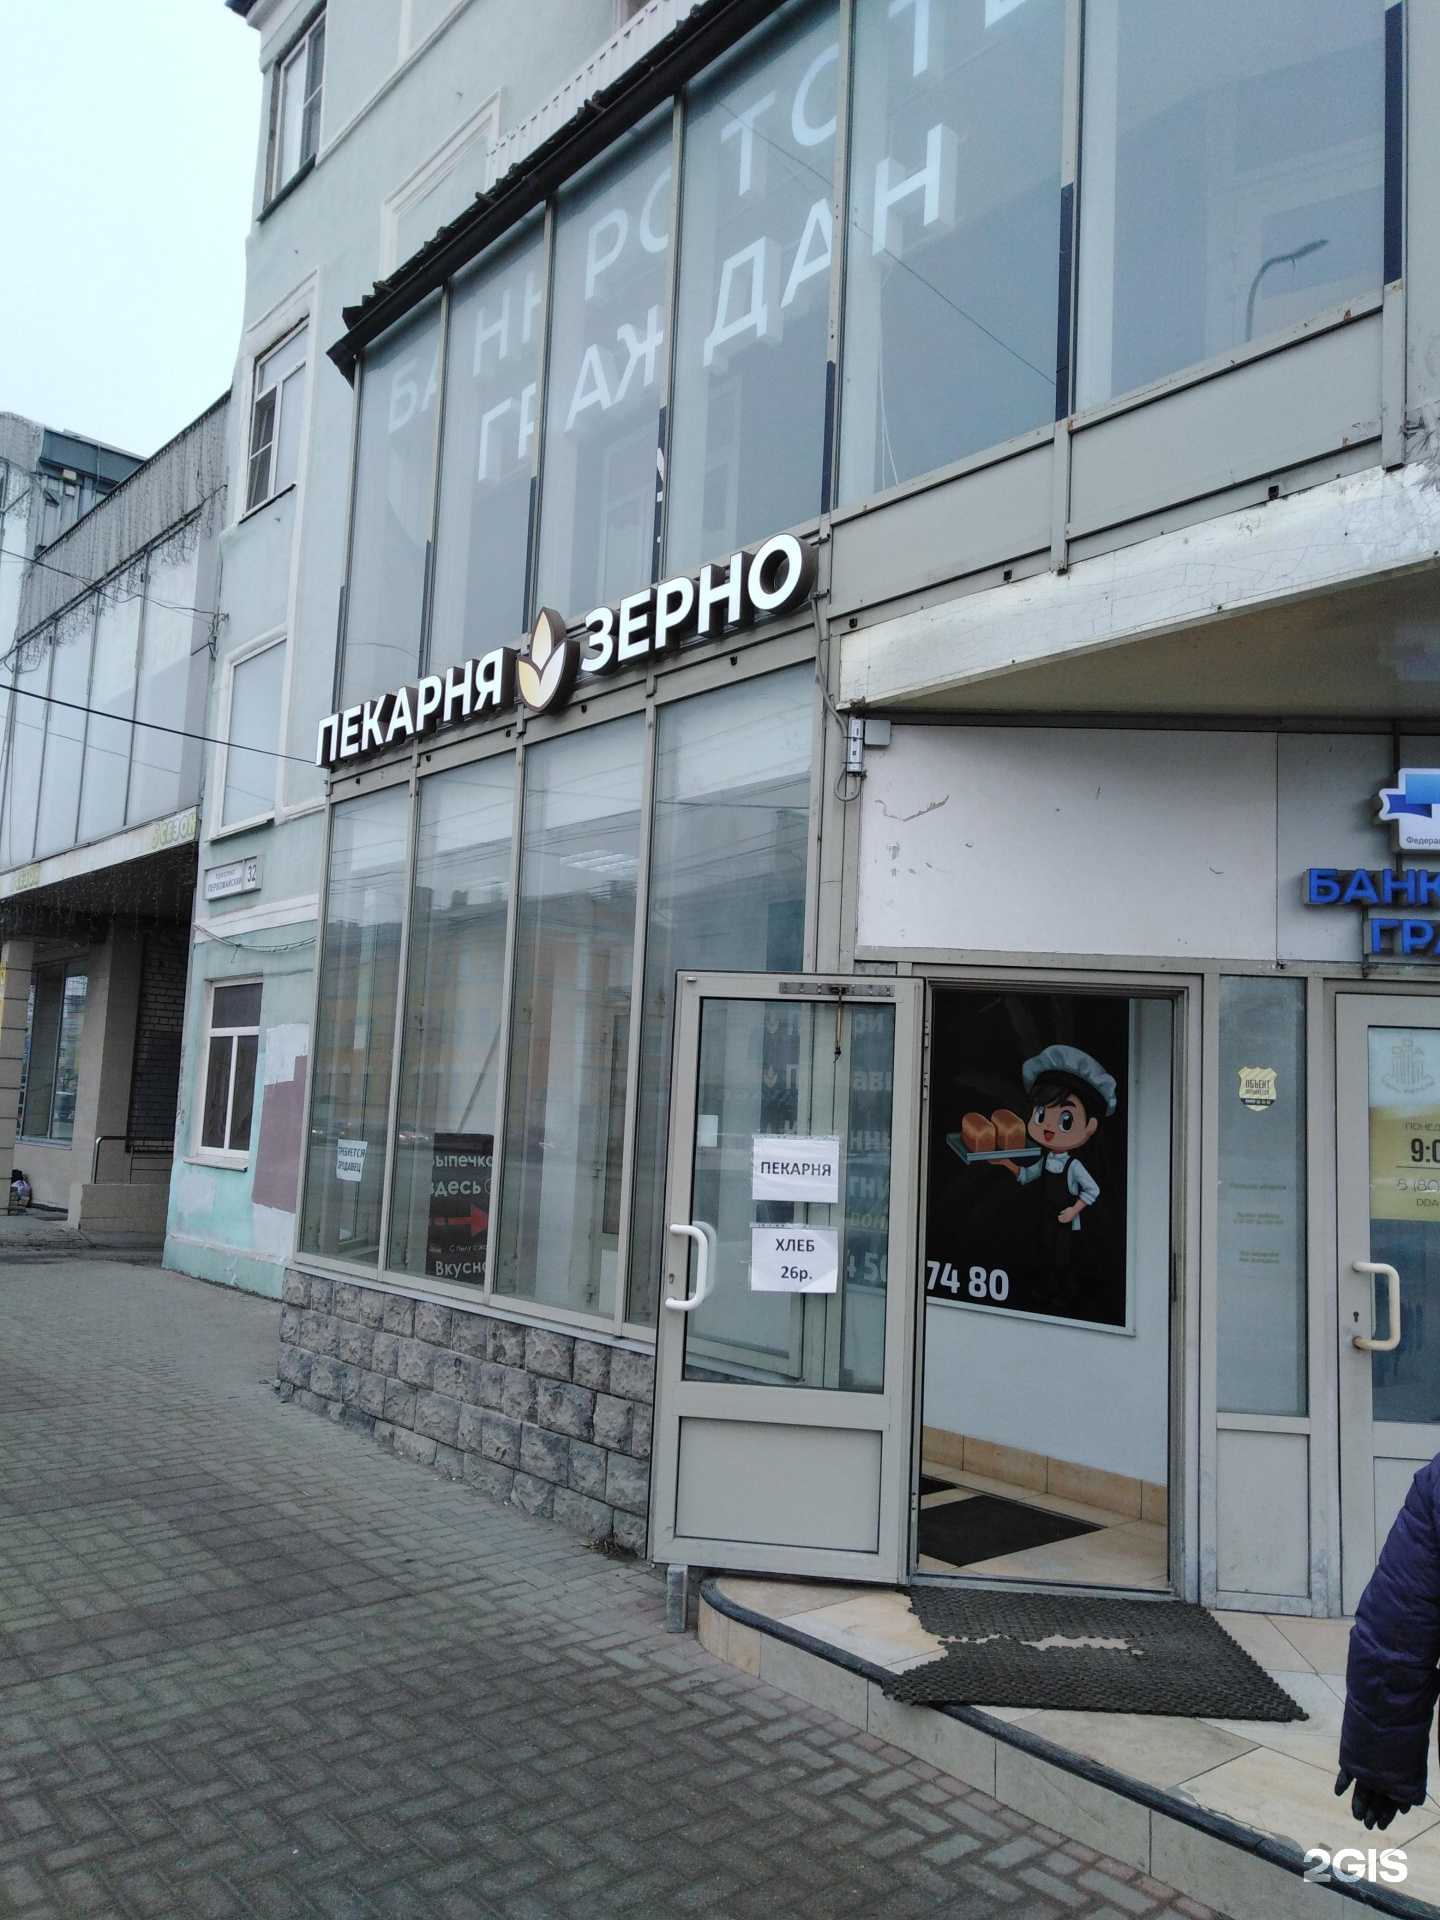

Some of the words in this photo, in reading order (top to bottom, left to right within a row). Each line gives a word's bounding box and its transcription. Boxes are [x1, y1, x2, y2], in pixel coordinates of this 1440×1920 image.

[316, 645, 505, 767] ПЕКАРНЯ
[581, 533, 803, 674] ЗЕРНО
[247, 864, 257, 883] 32
[760, 1161, 832, 1177] ПЕКАРНЯ
[775, 1238, 816, 1253] ХЛЕБ
[780, 1265, 813, 1282] 26р.
[926, 1260, 961, 1294] 74
[967, 1264, 1009, 1302] 80
